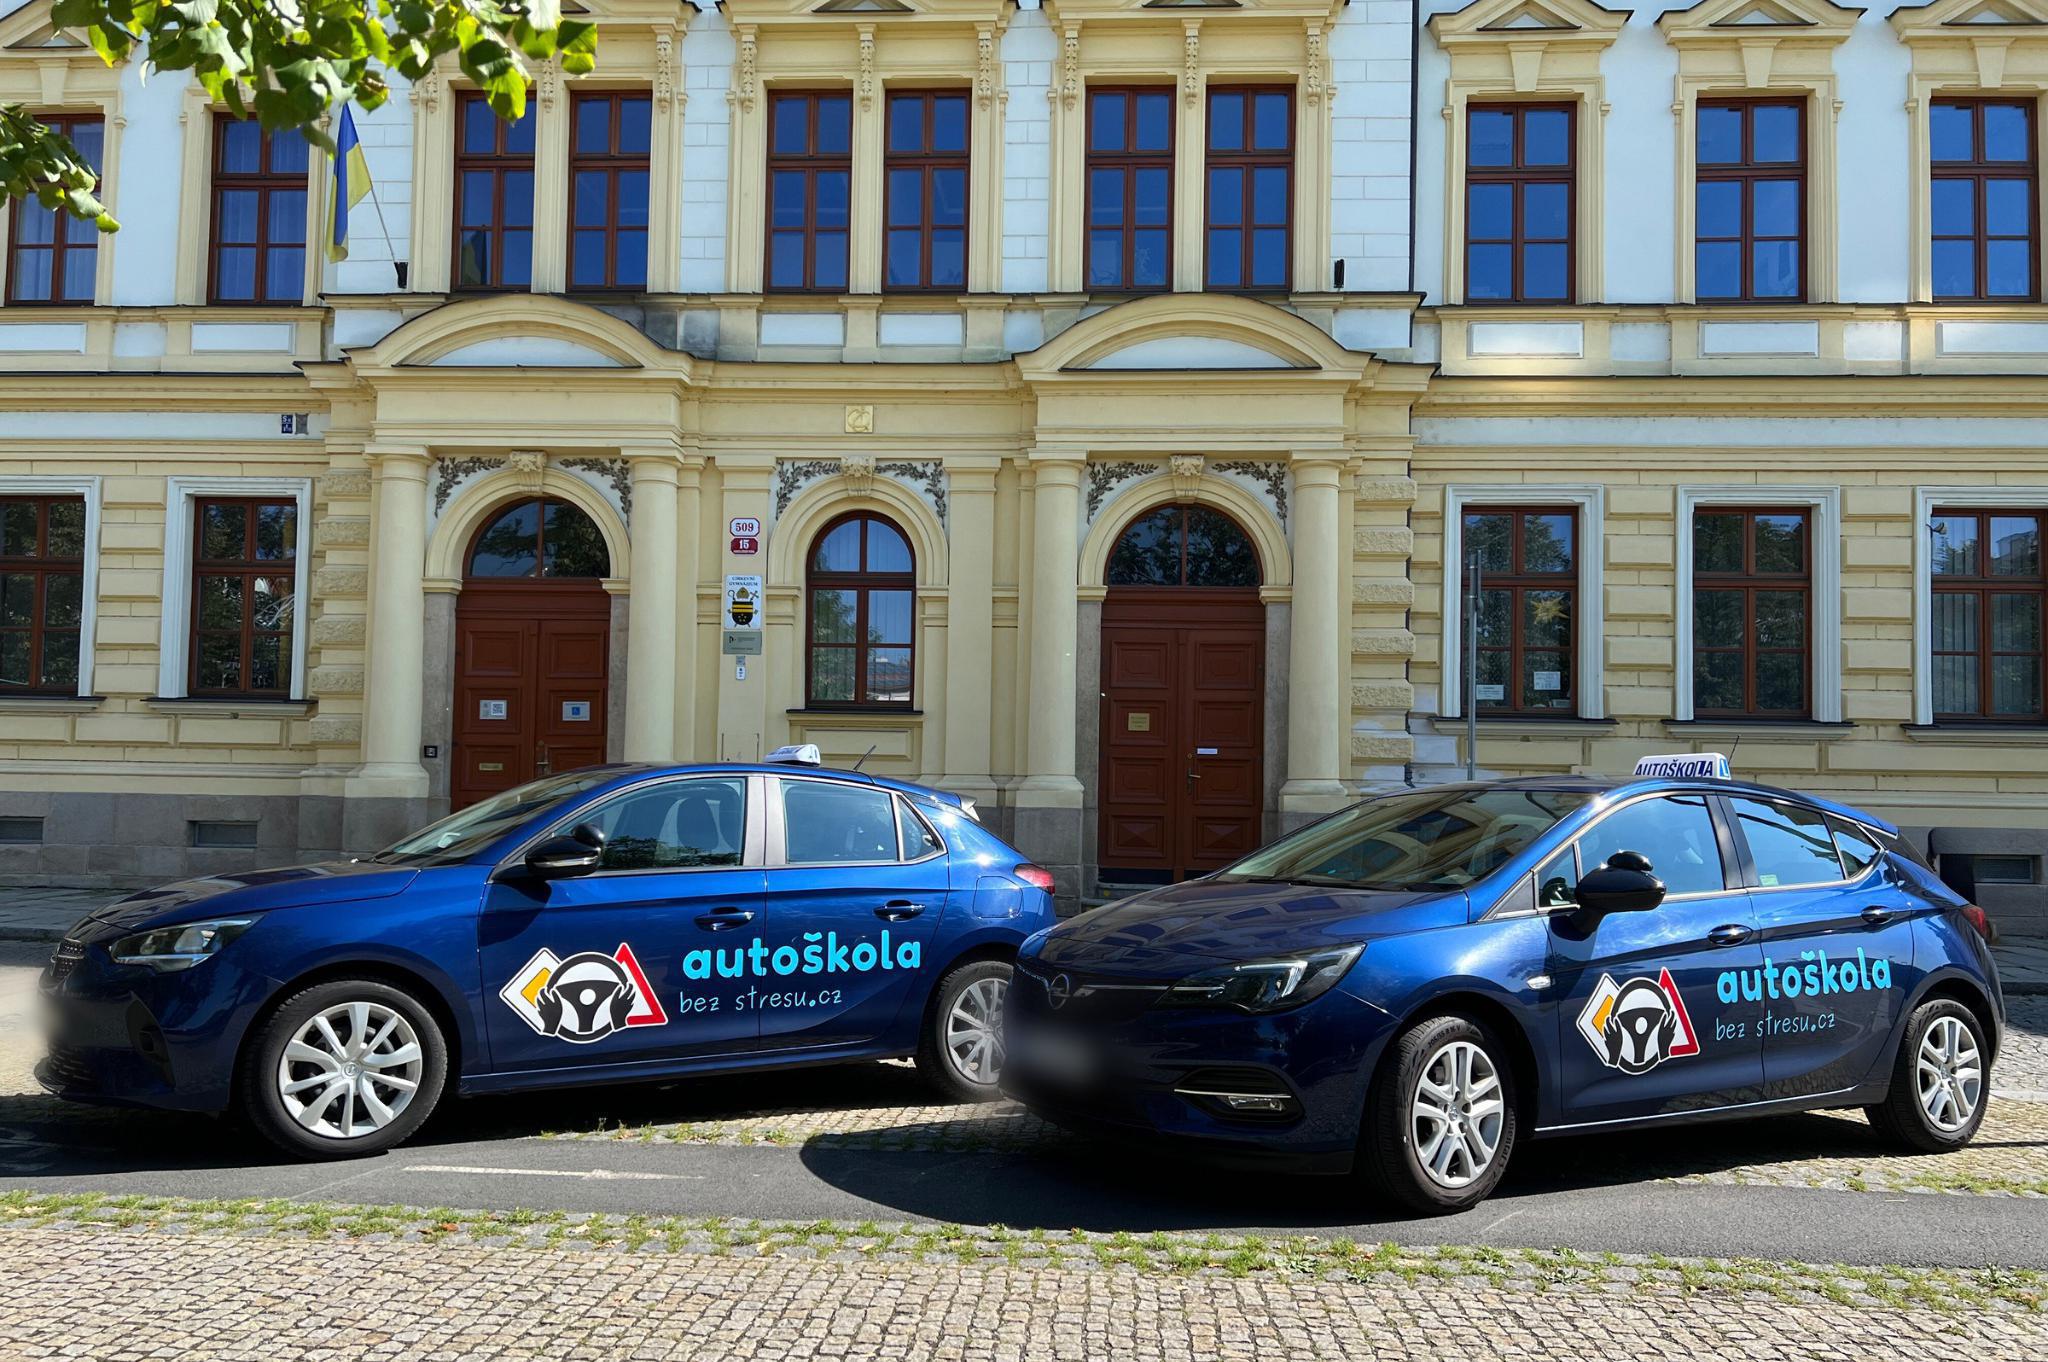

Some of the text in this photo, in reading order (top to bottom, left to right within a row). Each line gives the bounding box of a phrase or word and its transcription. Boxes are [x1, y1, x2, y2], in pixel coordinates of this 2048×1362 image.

[735, 522, 754, 532] 509
[739, 539, 750, 550] 15
[1635, 759, 1713, 777] AUTOŠKOLA
[682, 929, 922, 980] autoškola
[1716, 946, 1892, 1004] autoškola
[679, 985, 843, 1014] bez stresu.cz
[1715, 1009, 1836, 1042] bez stresu.cz
